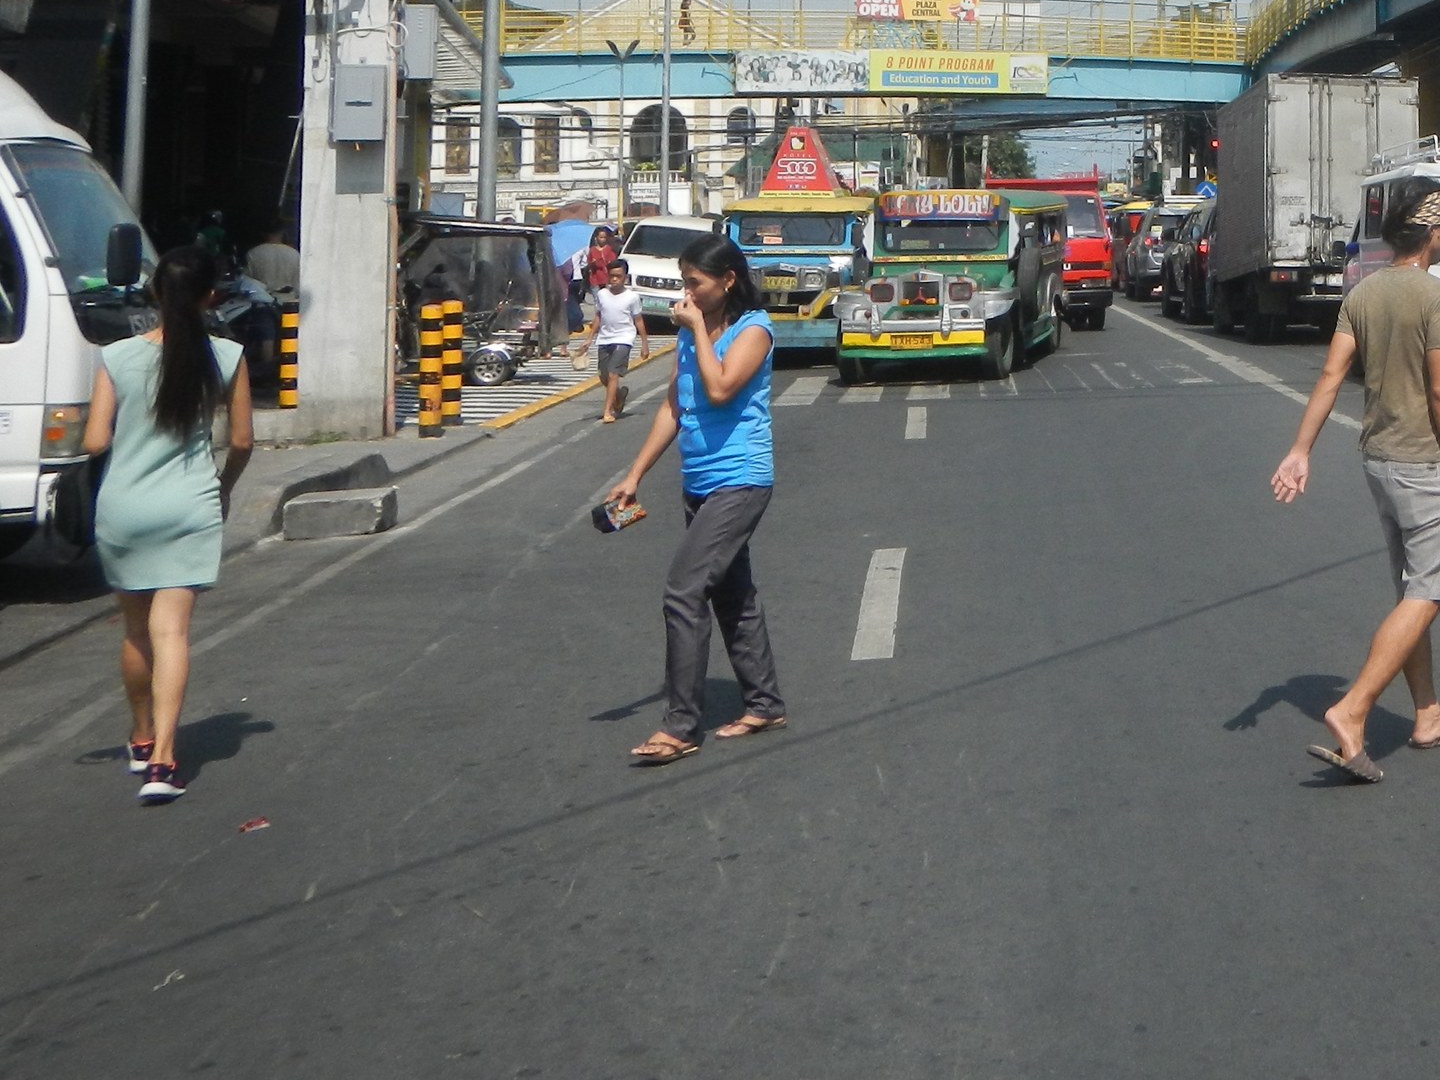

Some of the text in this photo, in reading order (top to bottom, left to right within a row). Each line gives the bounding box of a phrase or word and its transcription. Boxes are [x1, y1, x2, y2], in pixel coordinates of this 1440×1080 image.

[858, 3, 900, 17] OPEN
[915, 1, 938, 9] PLAZA
[911, 8, 942, 17] CENTRAL
[886, 56, 995, 71] 8 POINT PROGRAM
[889, 72, 992, 86] Education and Youth
